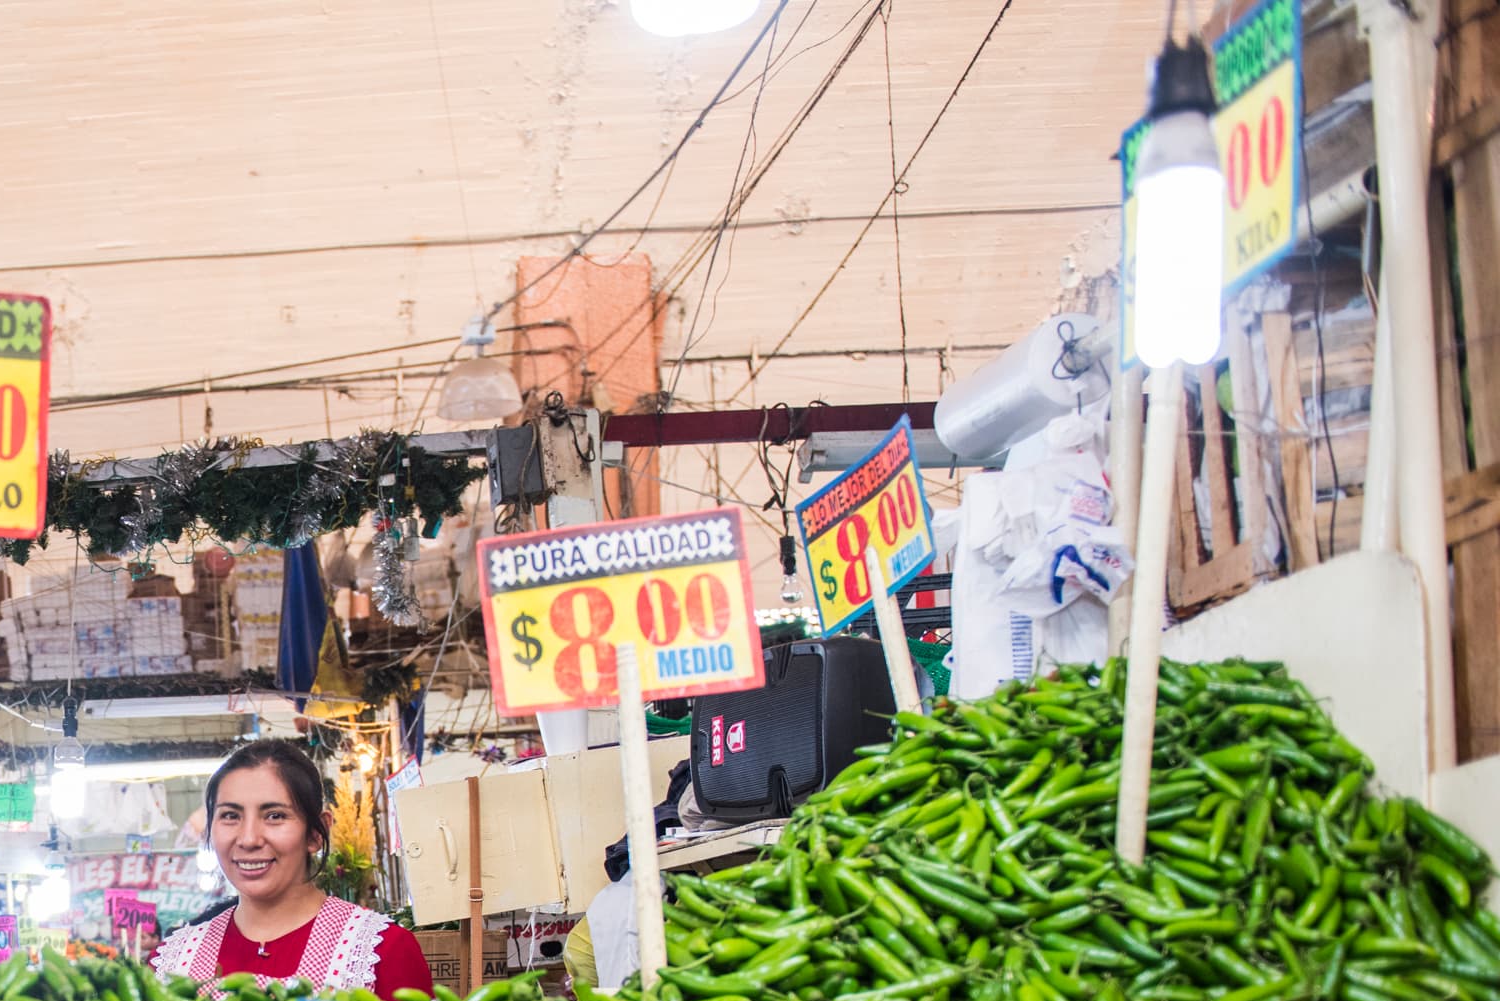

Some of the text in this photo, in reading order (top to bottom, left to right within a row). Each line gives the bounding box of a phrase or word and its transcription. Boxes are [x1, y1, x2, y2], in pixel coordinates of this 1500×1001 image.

[513, 529, 711, 576] PURA CALIDAD
[891, 537, 924, 577] MEDIO
[657, 644, 735, 678] MEDIO
[711, 718, 722, 763] KSR
[119, 855, 149, 886] EL
[430, 962, 461, 976] HRE
